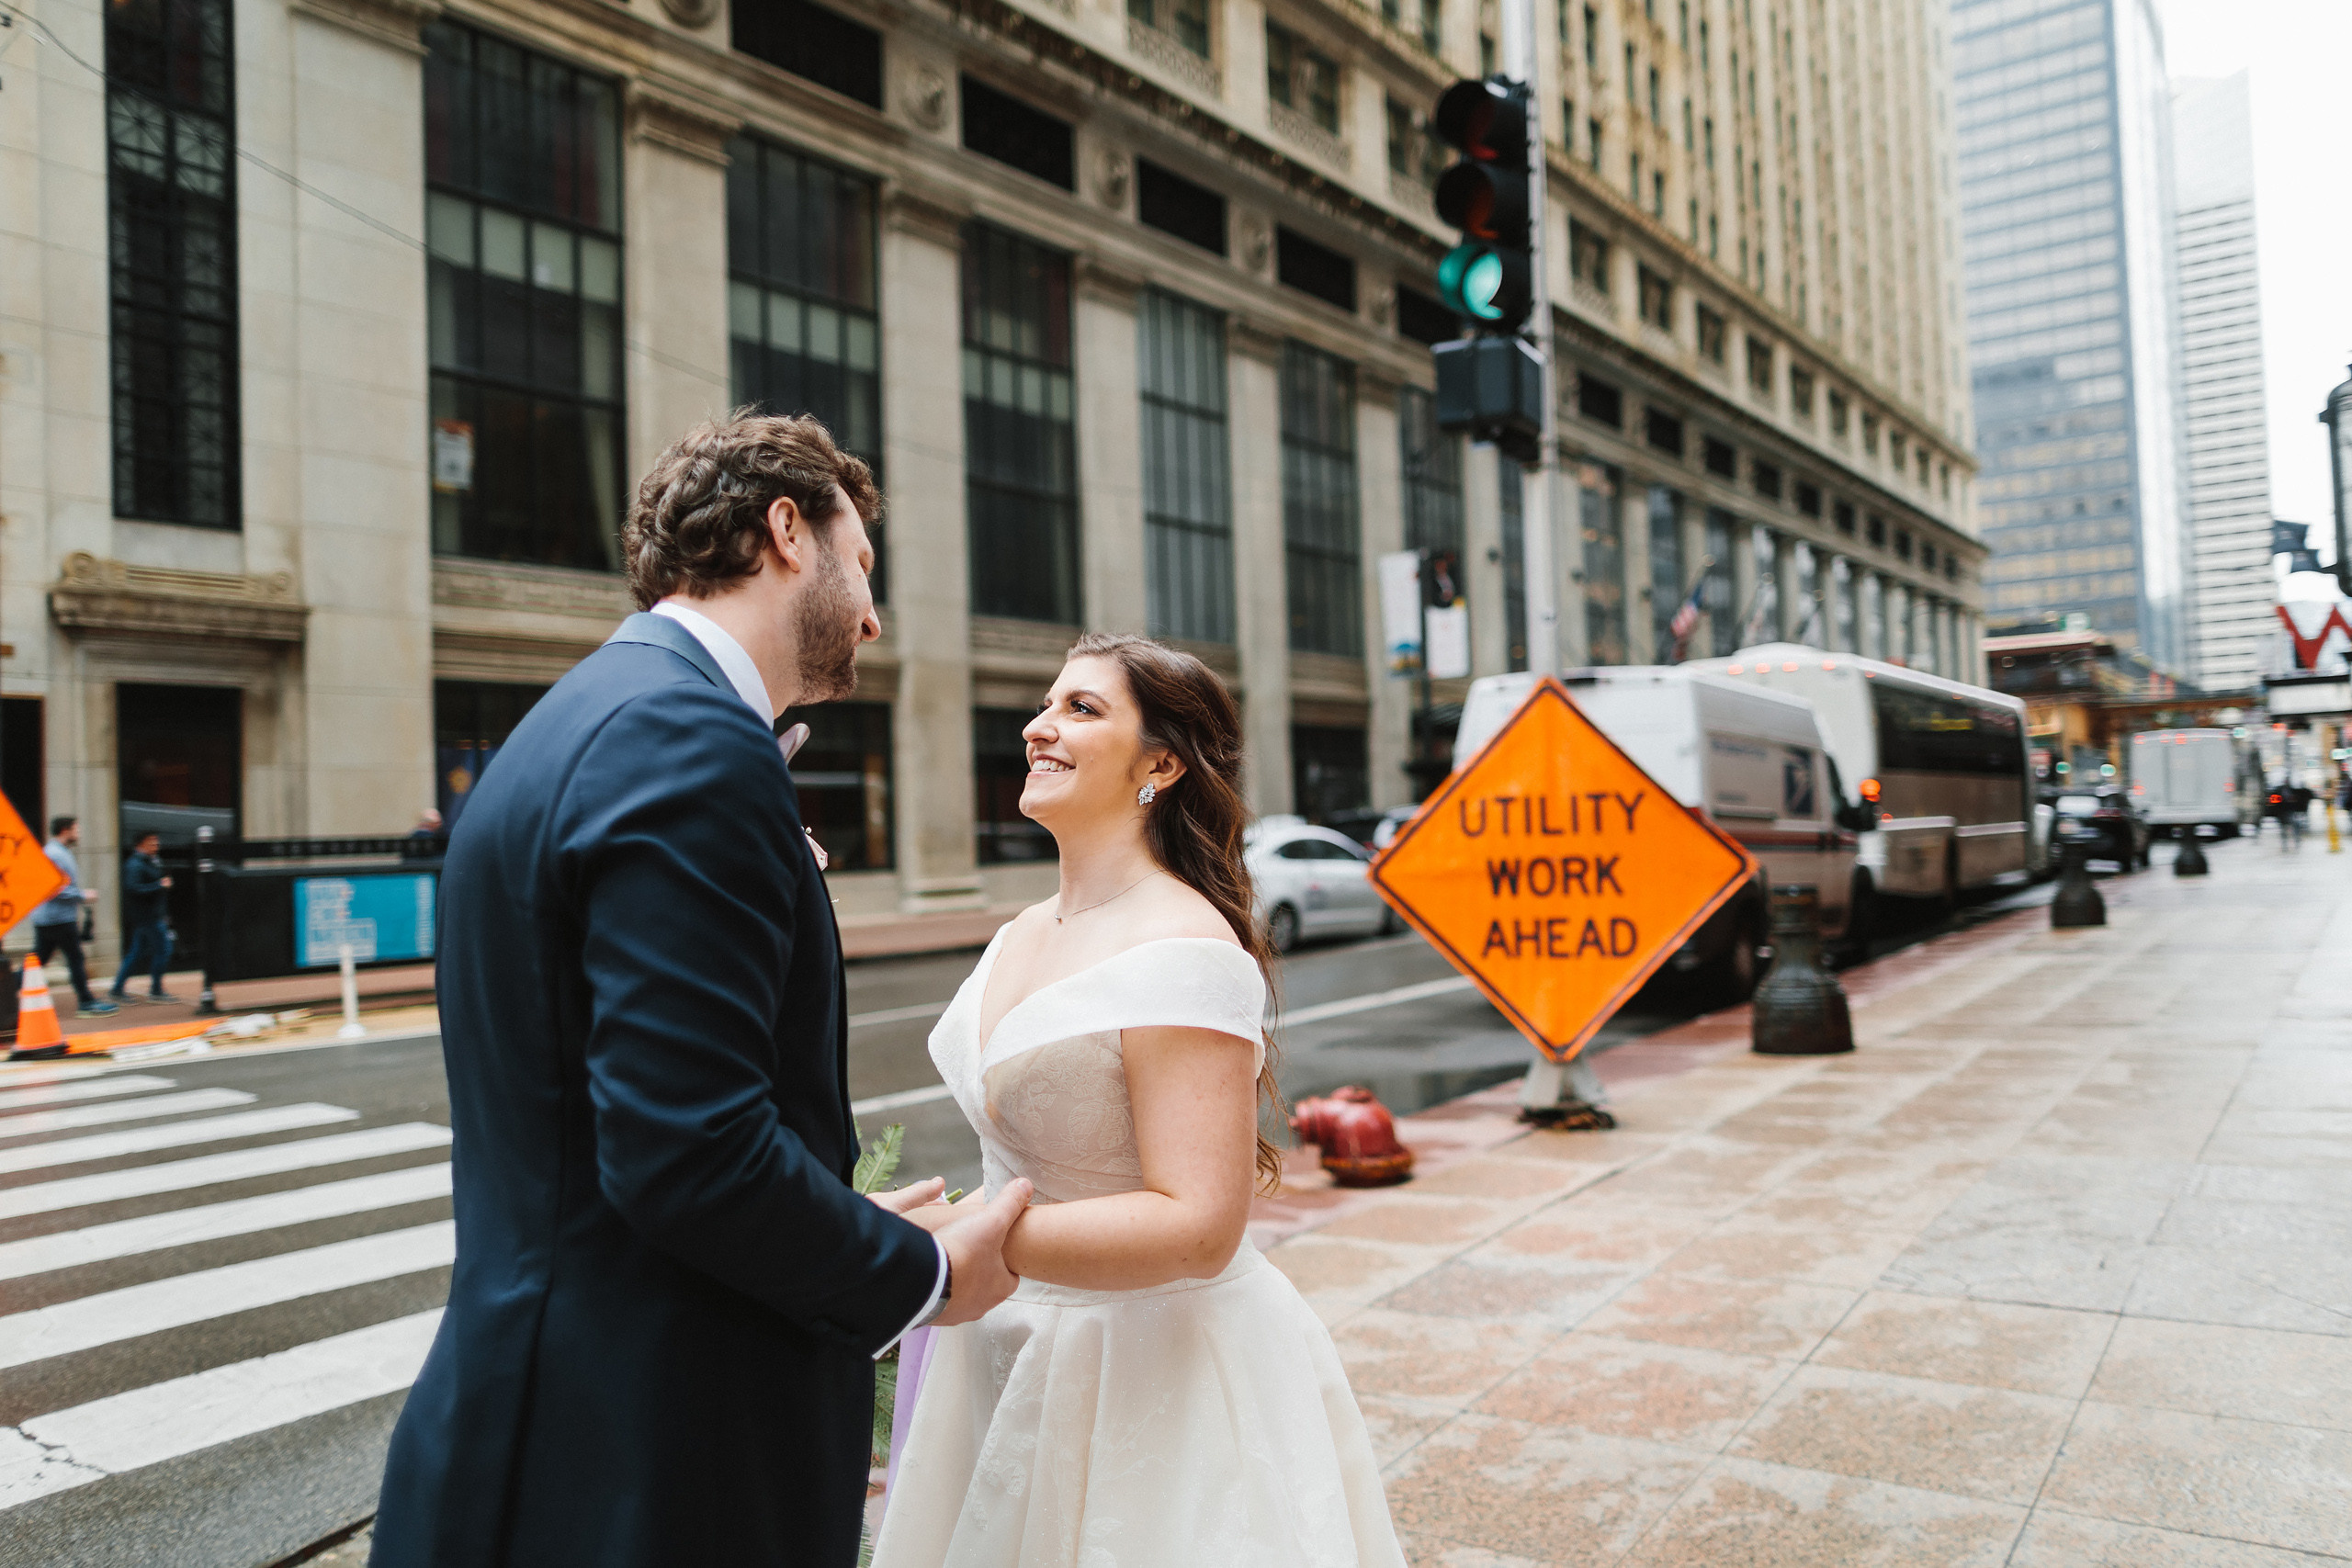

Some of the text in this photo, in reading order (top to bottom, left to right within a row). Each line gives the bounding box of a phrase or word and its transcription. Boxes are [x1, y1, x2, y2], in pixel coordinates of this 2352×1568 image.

[1459, 791, 1645, 838] UTILITY
[1487, 854, 1623, 897] WORK
[1481, 917, 1637, 958] AHEAD
